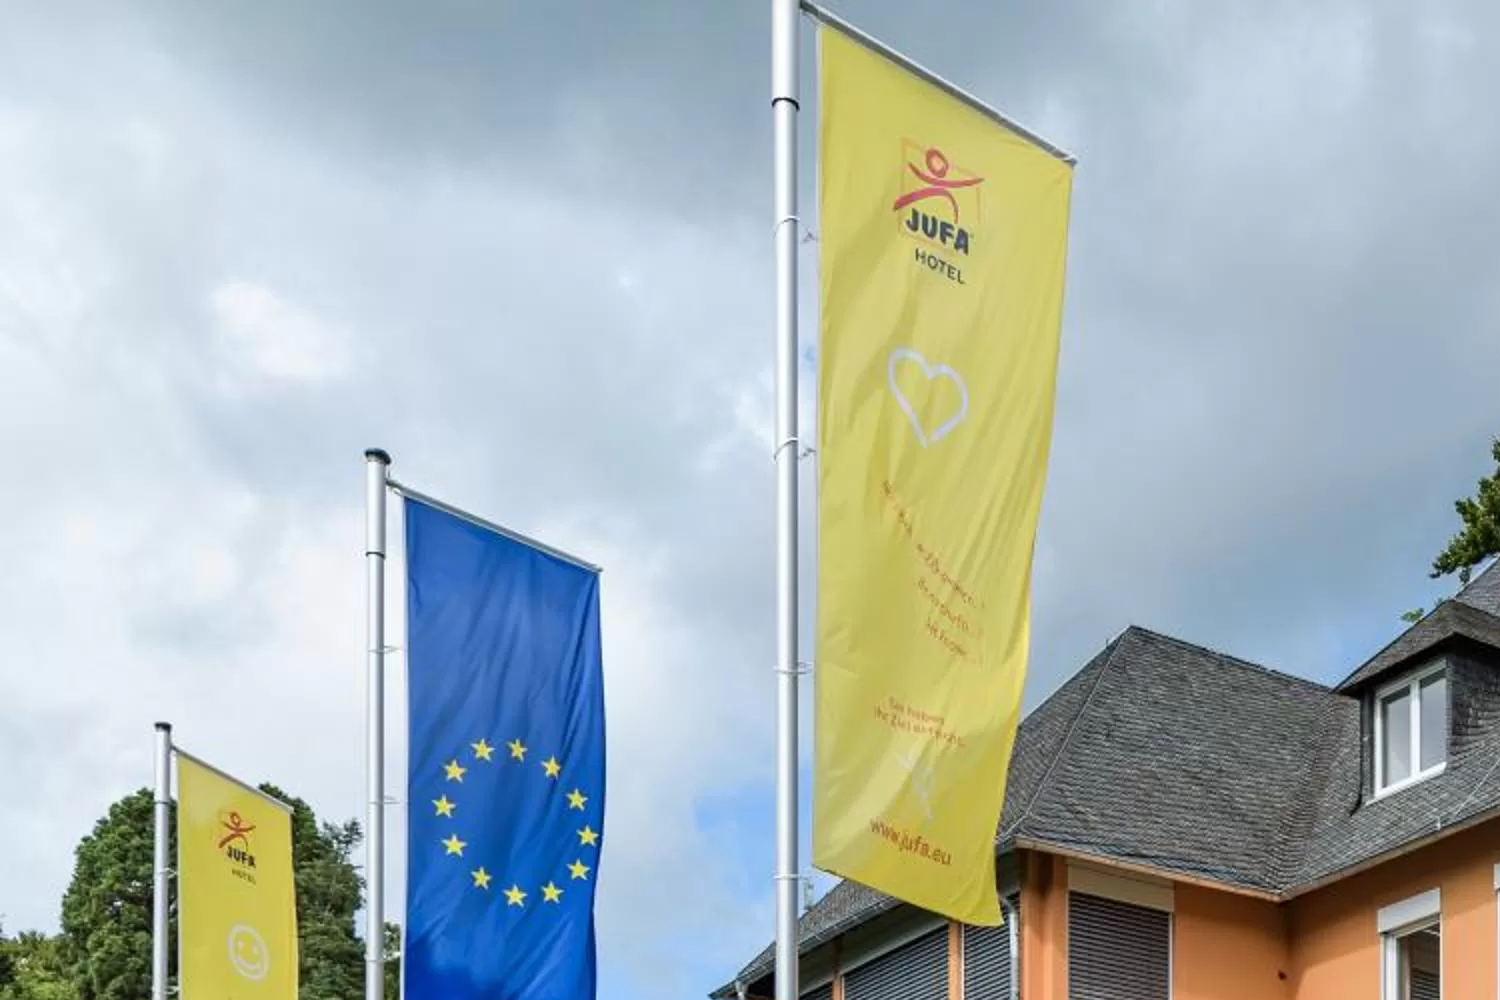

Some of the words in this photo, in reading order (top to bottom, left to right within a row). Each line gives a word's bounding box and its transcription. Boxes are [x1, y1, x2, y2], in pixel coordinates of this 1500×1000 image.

[905, 208, 970, 255] JUFA
[915, 248, 966, 284] HOTEL
[227, 846, 257, 868] JUFA
